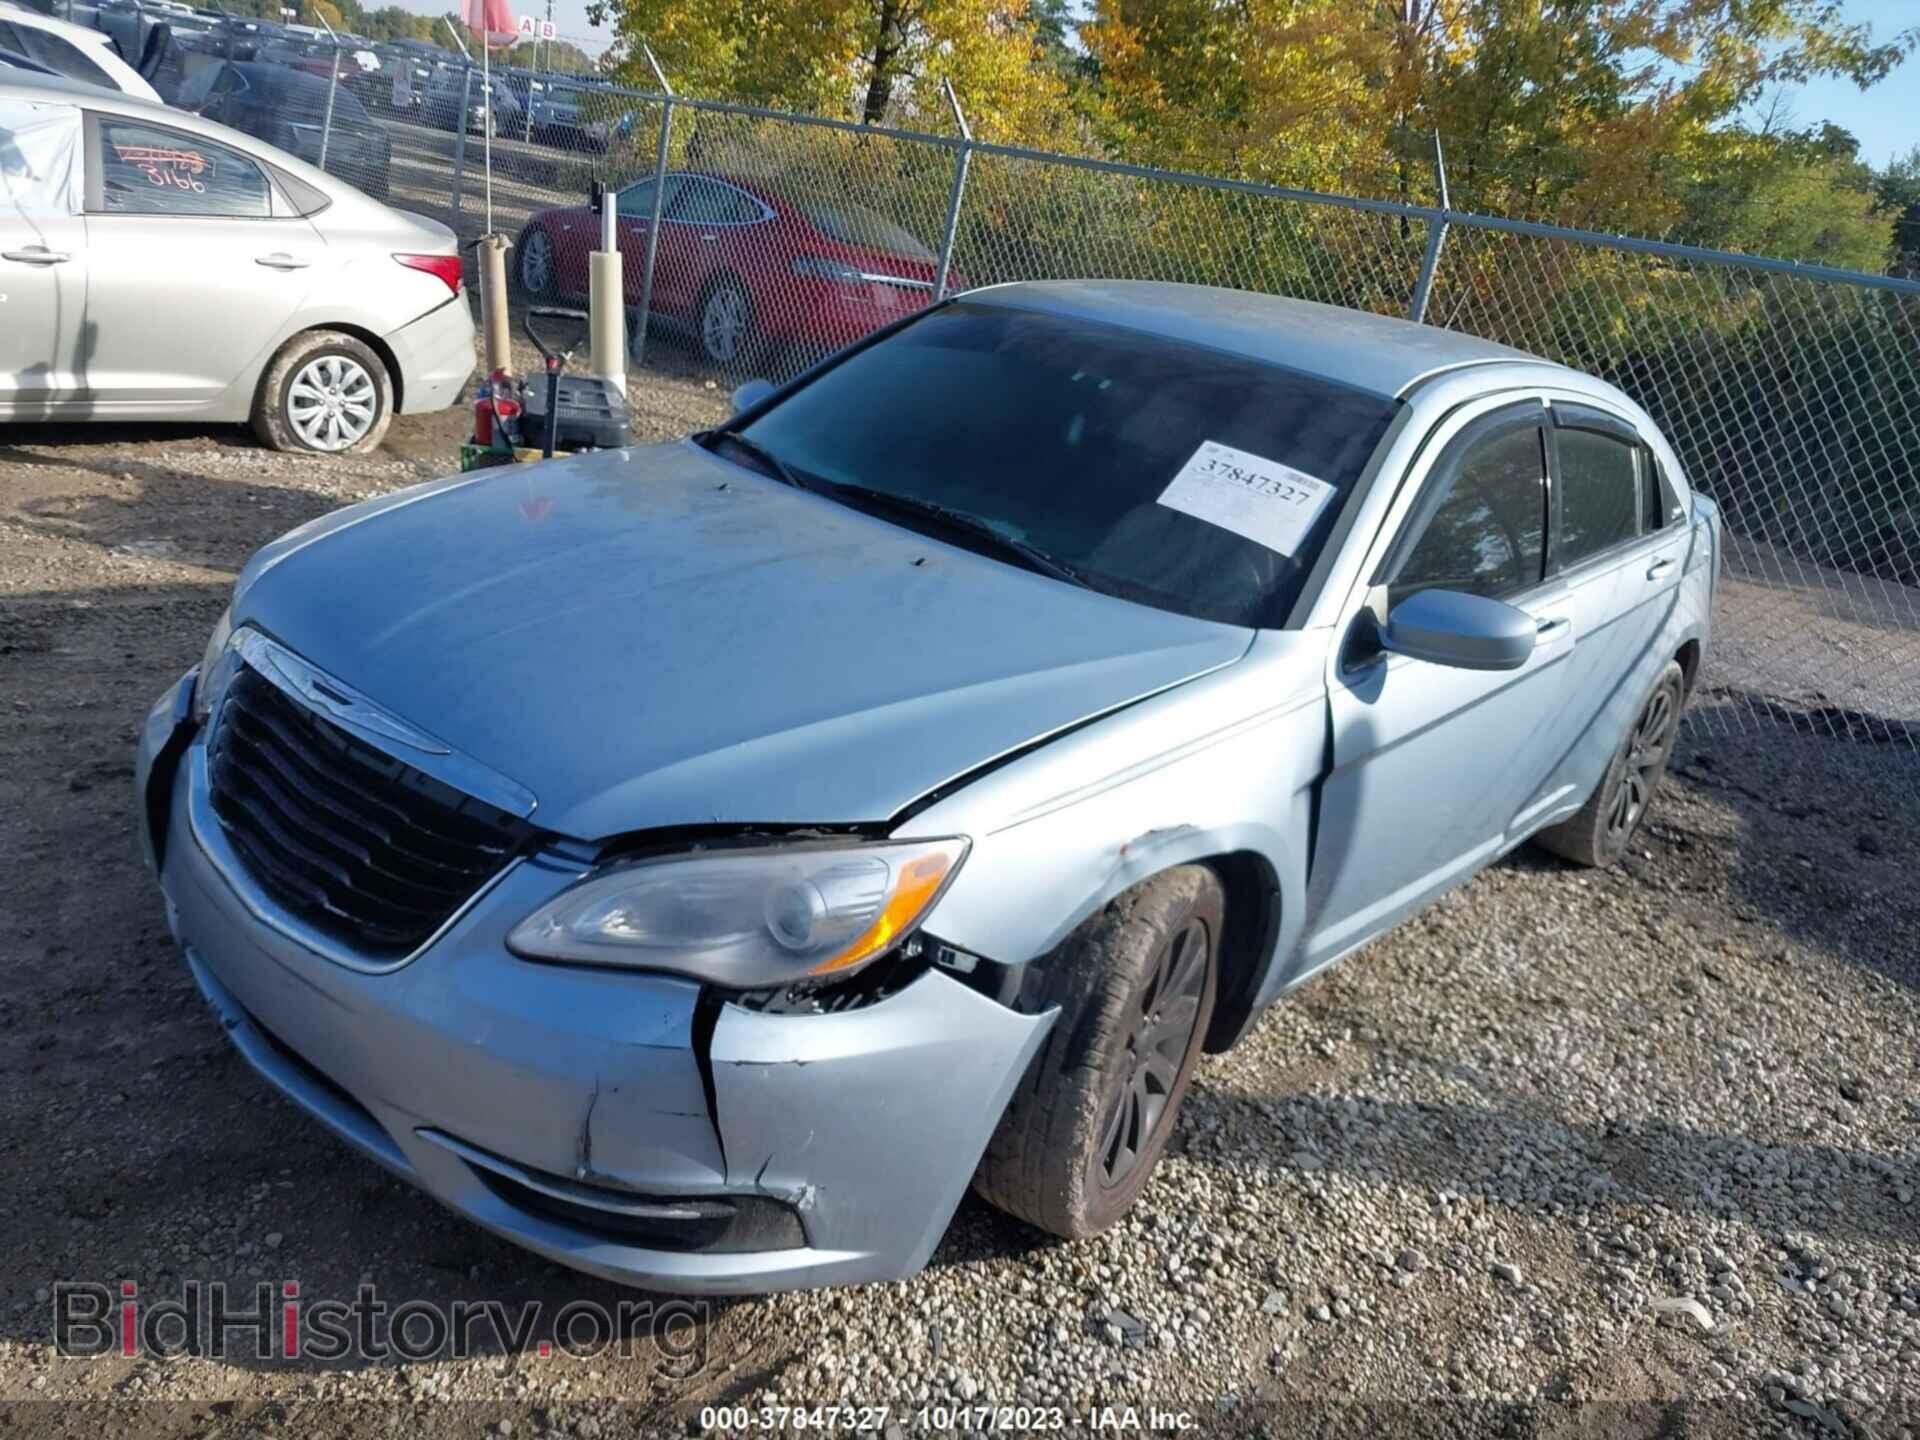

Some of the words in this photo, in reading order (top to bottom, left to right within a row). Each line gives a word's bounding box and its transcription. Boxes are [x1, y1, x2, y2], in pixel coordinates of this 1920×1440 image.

[521, 19, 532, 33] A
[543, 23, 553, 37] B
[1200, 458, 1310, 506] 37847327
